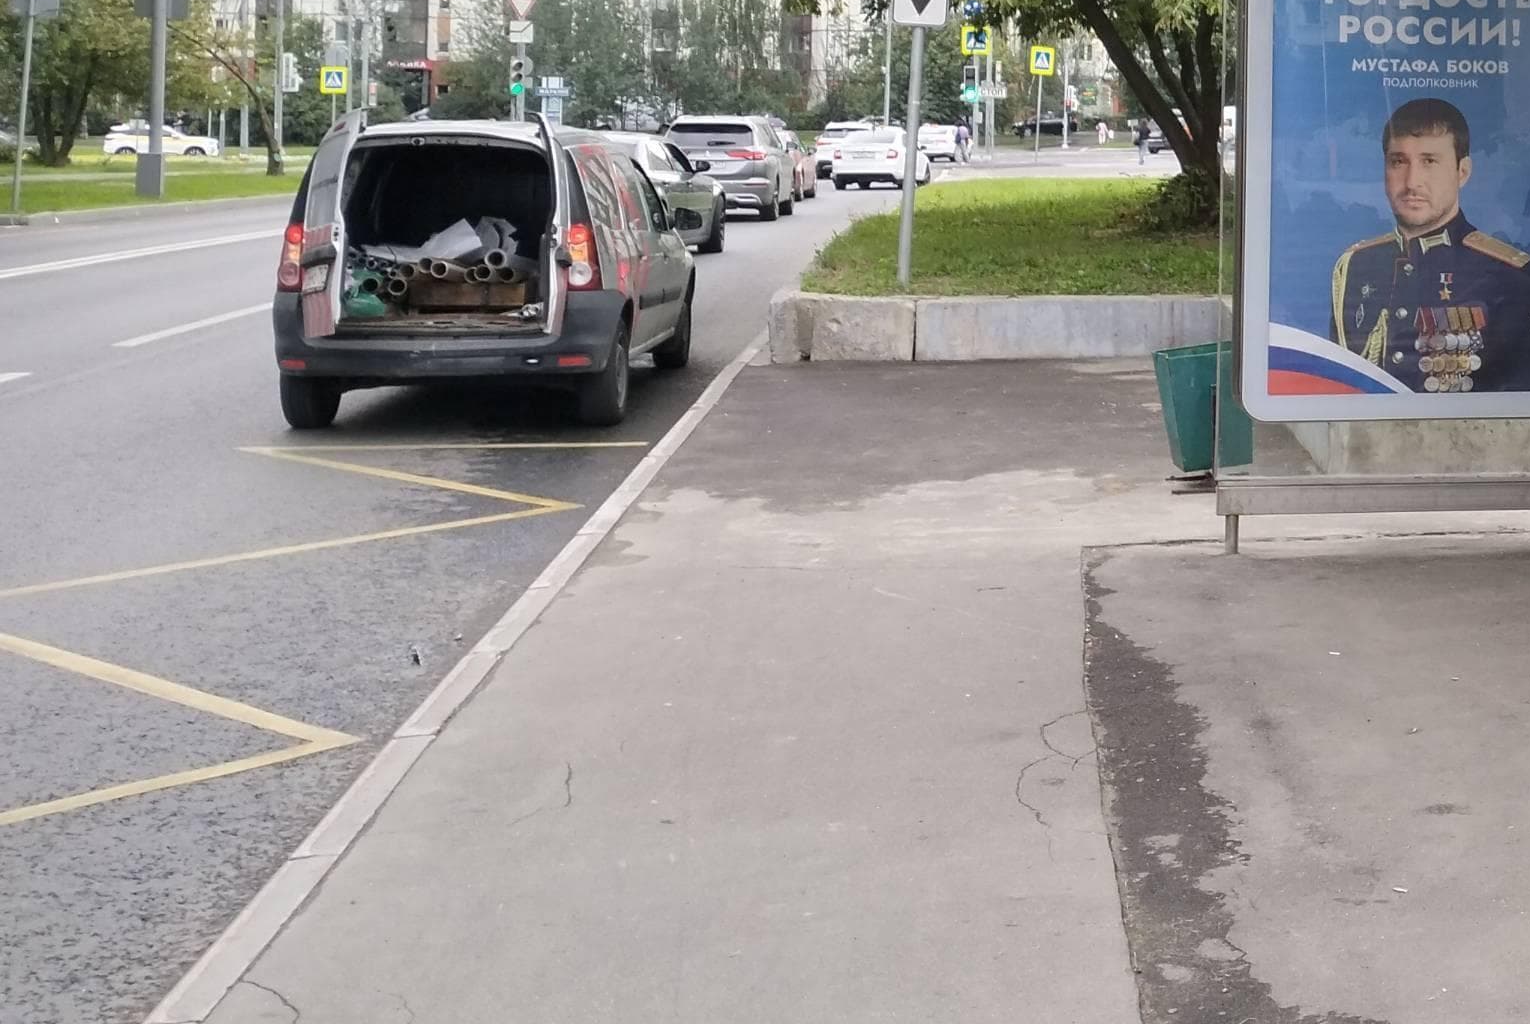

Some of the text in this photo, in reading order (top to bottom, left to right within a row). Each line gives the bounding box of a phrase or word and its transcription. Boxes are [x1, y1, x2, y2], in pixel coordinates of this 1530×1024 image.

[1338, 15, 1521, 47] РОССИИ!
[1351, 58, 1510, 74] МУСТАФА БОКОВ
[1382, 77, 1480, 89] ПОДПОЛКОВНИК
